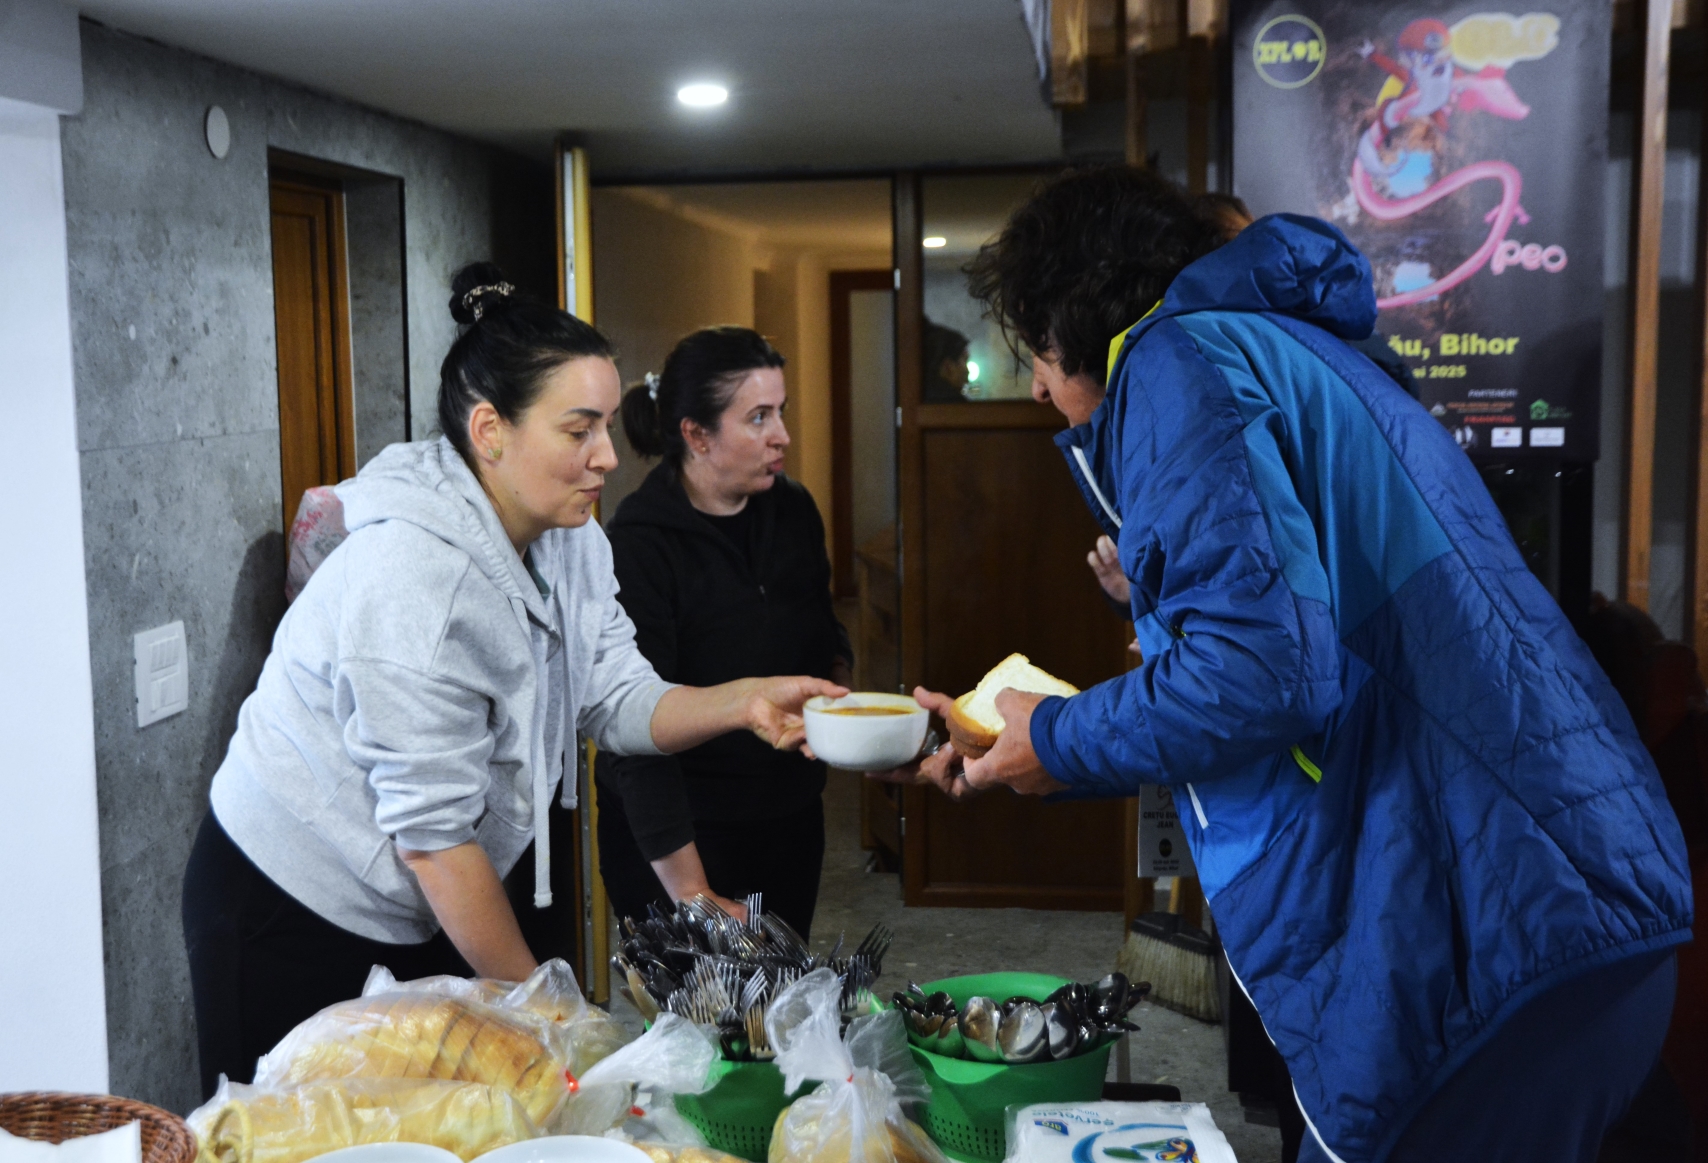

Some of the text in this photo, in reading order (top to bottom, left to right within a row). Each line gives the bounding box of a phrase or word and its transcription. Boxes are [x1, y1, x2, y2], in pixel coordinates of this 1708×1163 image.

[1388, 333, 1520, 360] ău, Bihor
[1412, 365, 1467, 378] ai 2025
[1157, 820, 1174, 828] JEAN
[1041, 1120, 1063, 1132] aro
